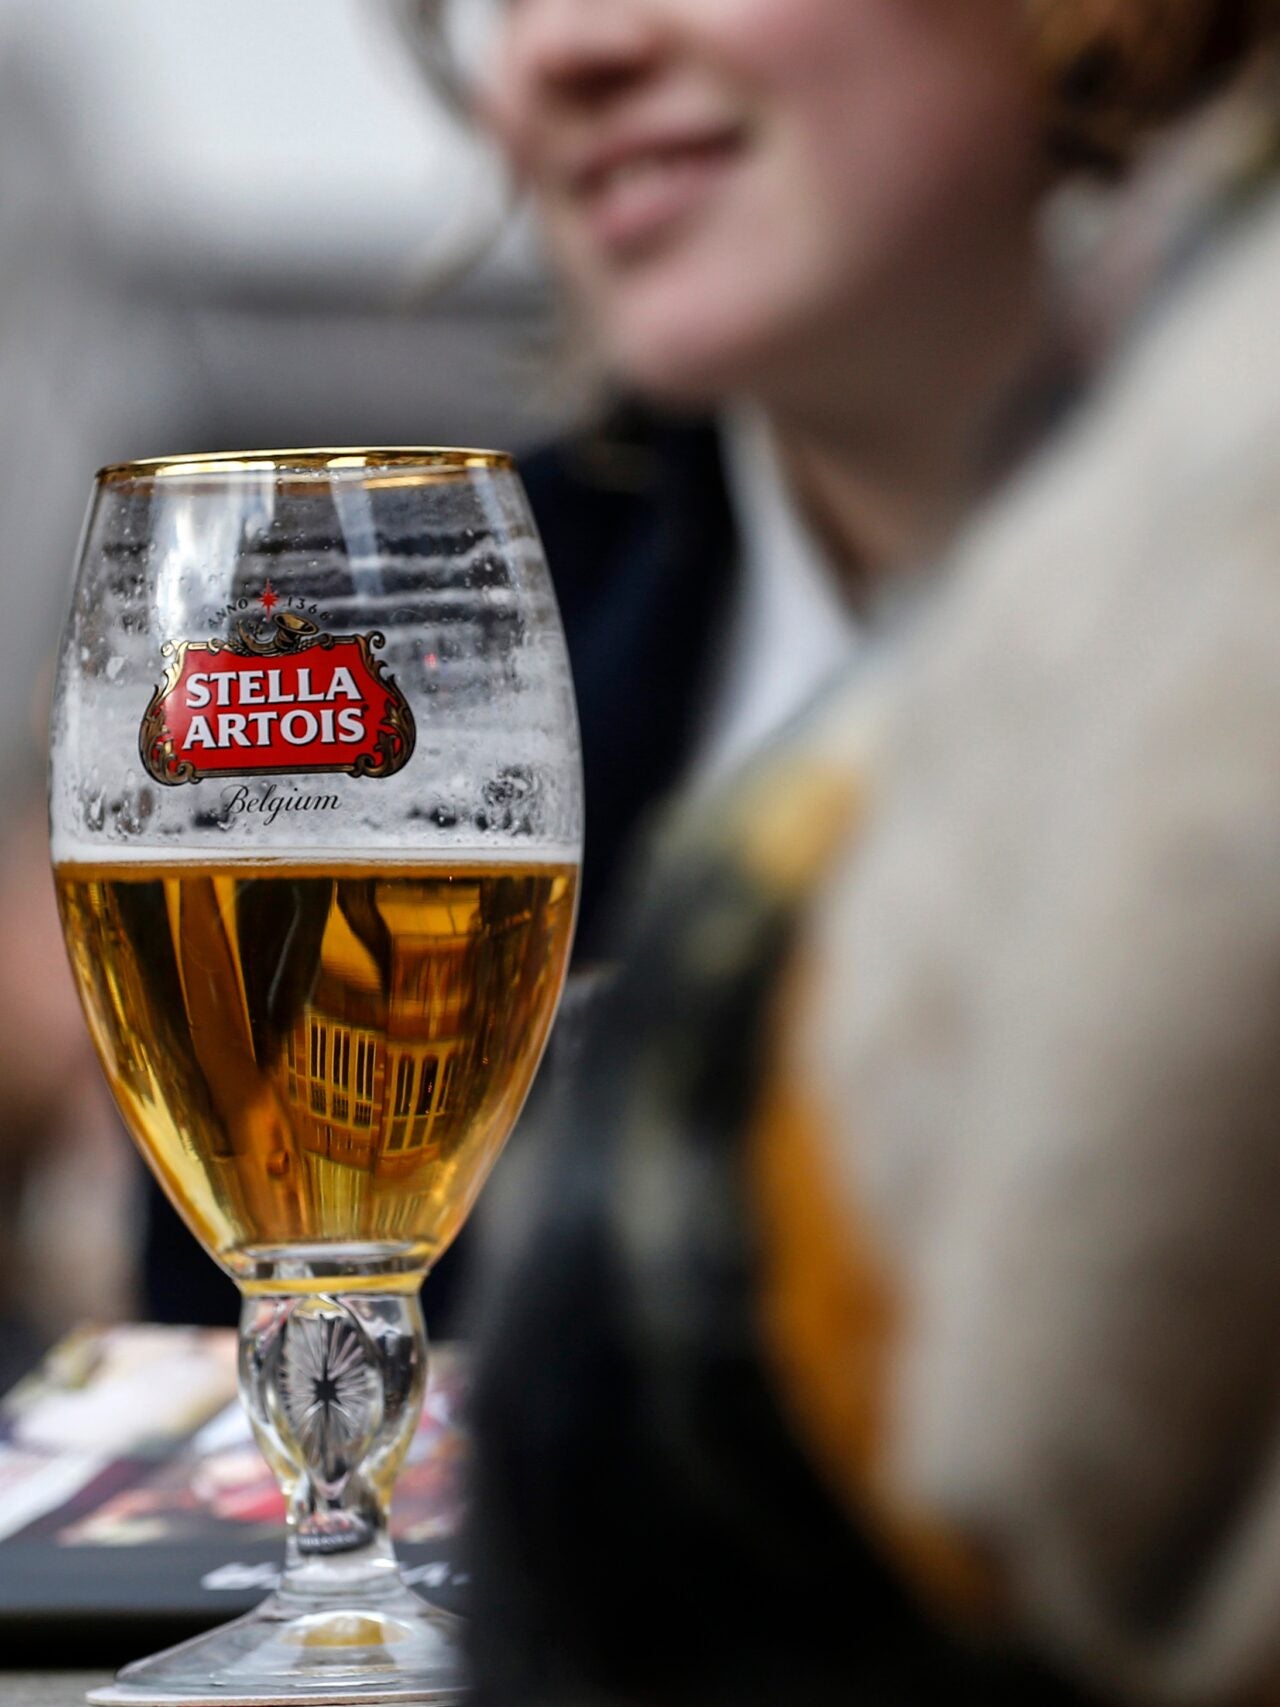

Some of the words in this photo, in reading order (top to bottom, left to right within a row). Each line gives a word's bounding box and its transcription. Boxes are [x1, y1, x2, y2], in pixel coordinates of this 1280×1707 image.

[207, 598, 248, 627] ANNO
[287, 596, 329, 620] 1366
[185, 667, 362, 708] STELLA
[182, 708, 365, 749] ARTOIS
[221, 784, 341, 825] Belgium
